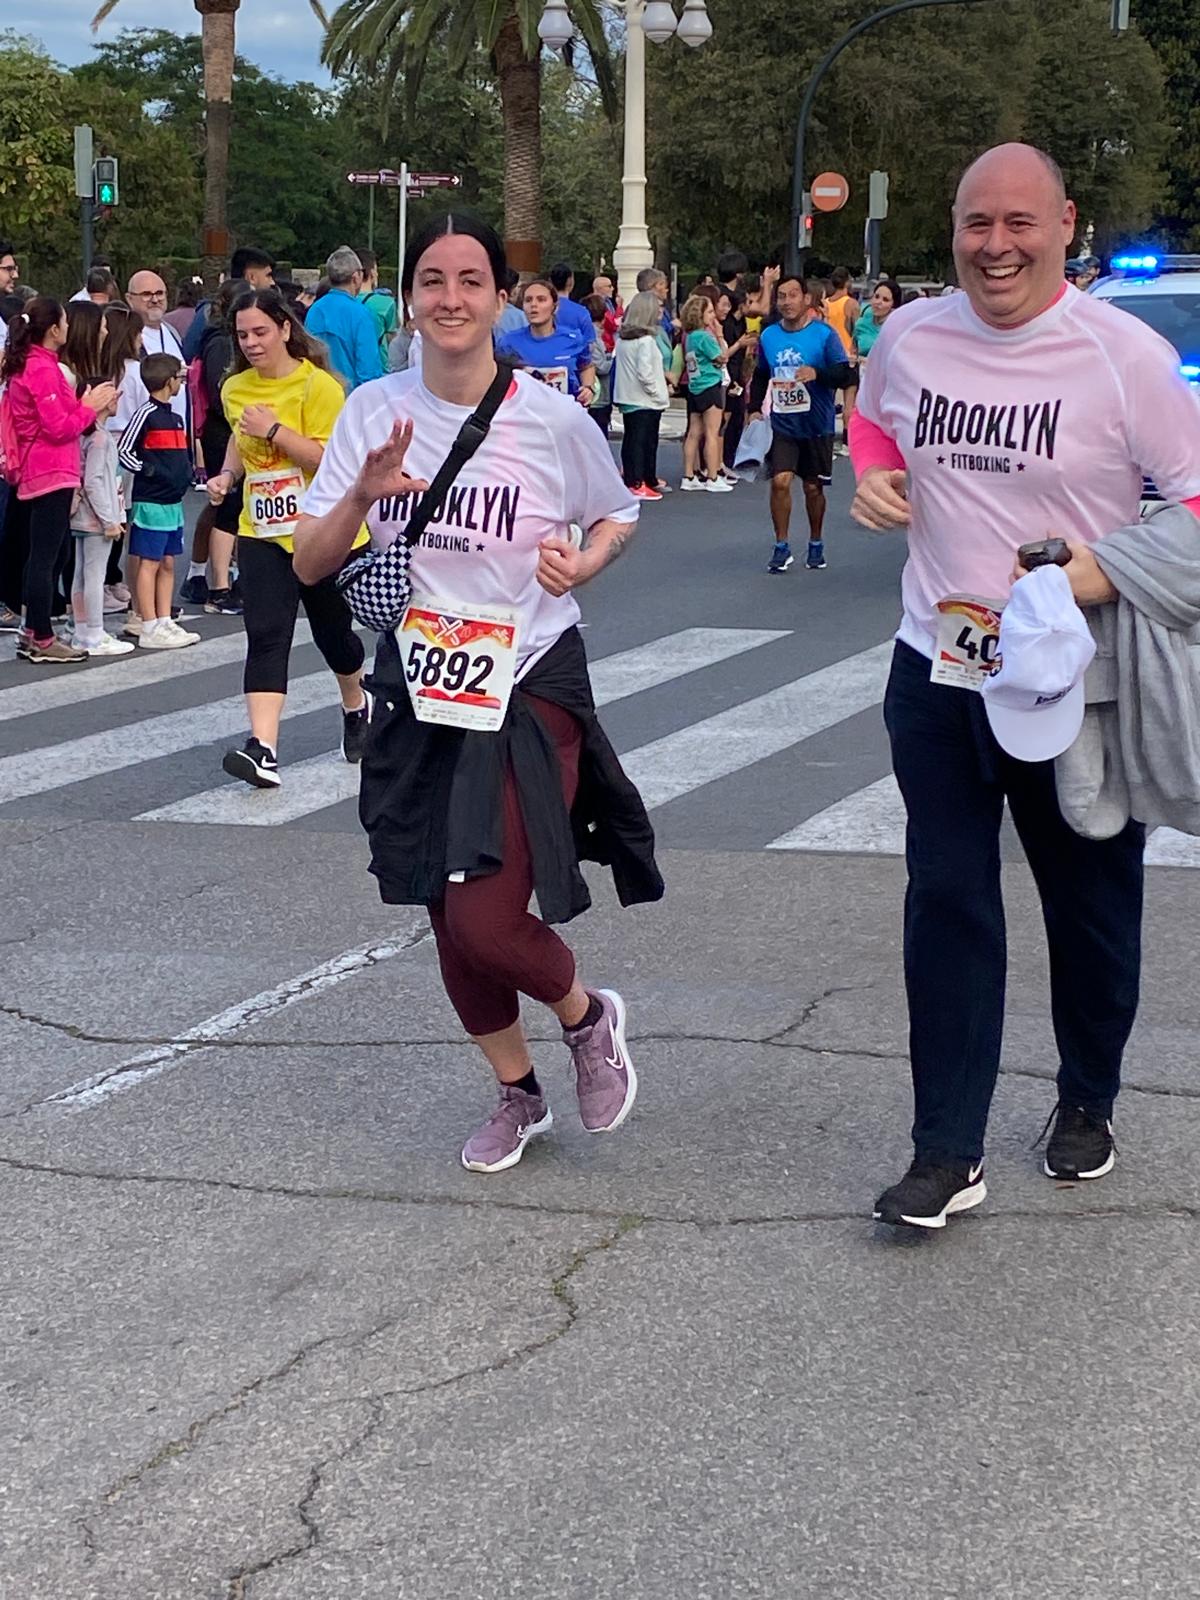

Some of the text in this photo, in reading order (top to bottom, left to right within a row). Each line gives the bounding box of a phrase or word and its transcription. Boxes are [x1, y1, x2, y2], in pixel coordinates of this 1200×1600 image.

[914, 387, 1062, 460] BROOKLYN
[951, 452, 1011, 474] FITBOXING
[255, 494, 297, 520] 6086
[379, 485, 520, 542] RKLYN
[417, 531, 470, 553] TBOXING
[406, 641, 494, 696] 5892
